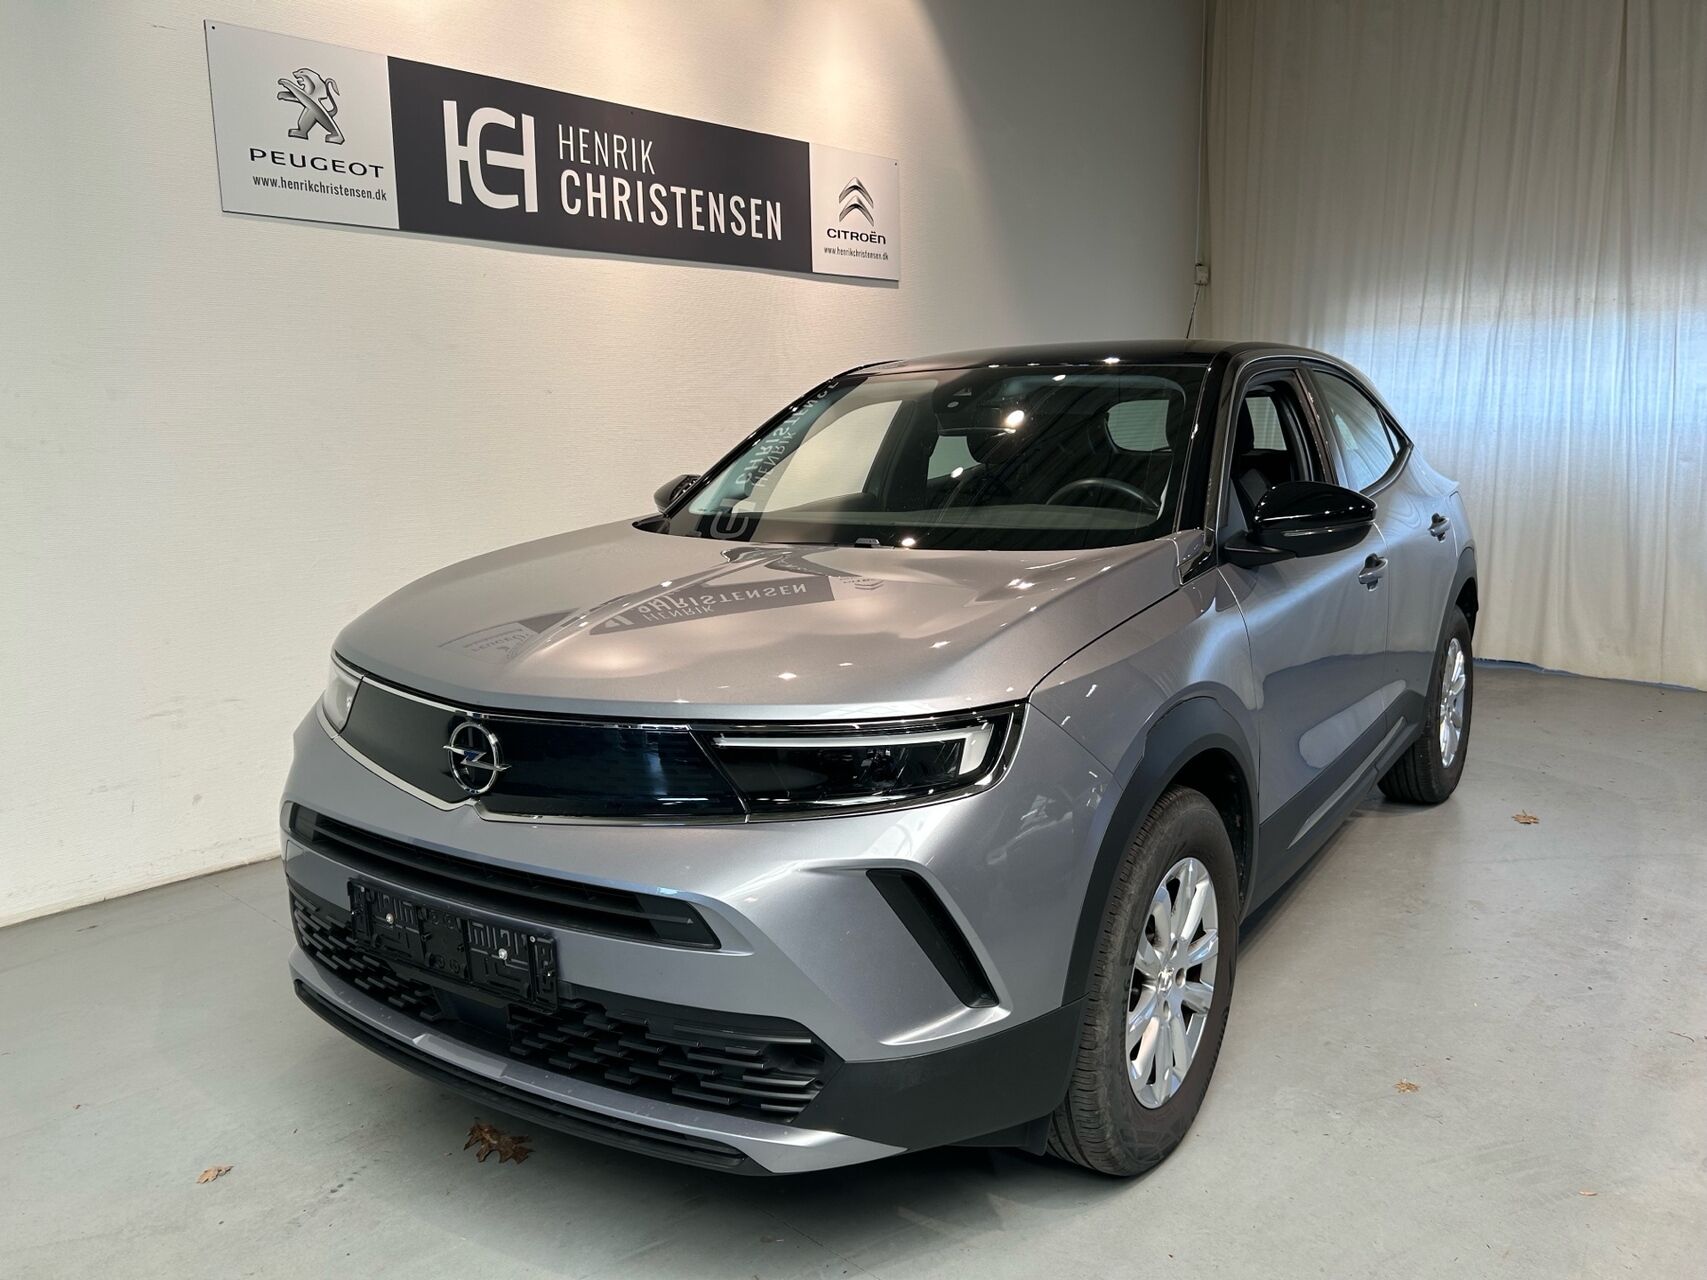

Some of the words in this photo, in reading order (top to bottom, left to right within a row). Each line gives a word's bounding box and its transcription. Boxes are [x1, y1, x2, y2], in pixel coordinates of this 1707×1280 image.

[250, 148, 384, 178] PEUGEOT
[558, 124, 655, 175] HENRIK
[253, 176, 387, 201] www.henrikchristensen.dk
[560, 169, 782, 241] CHRISTENSEN
[824, 246, 888, 261] www.henrikchristensen.dk
